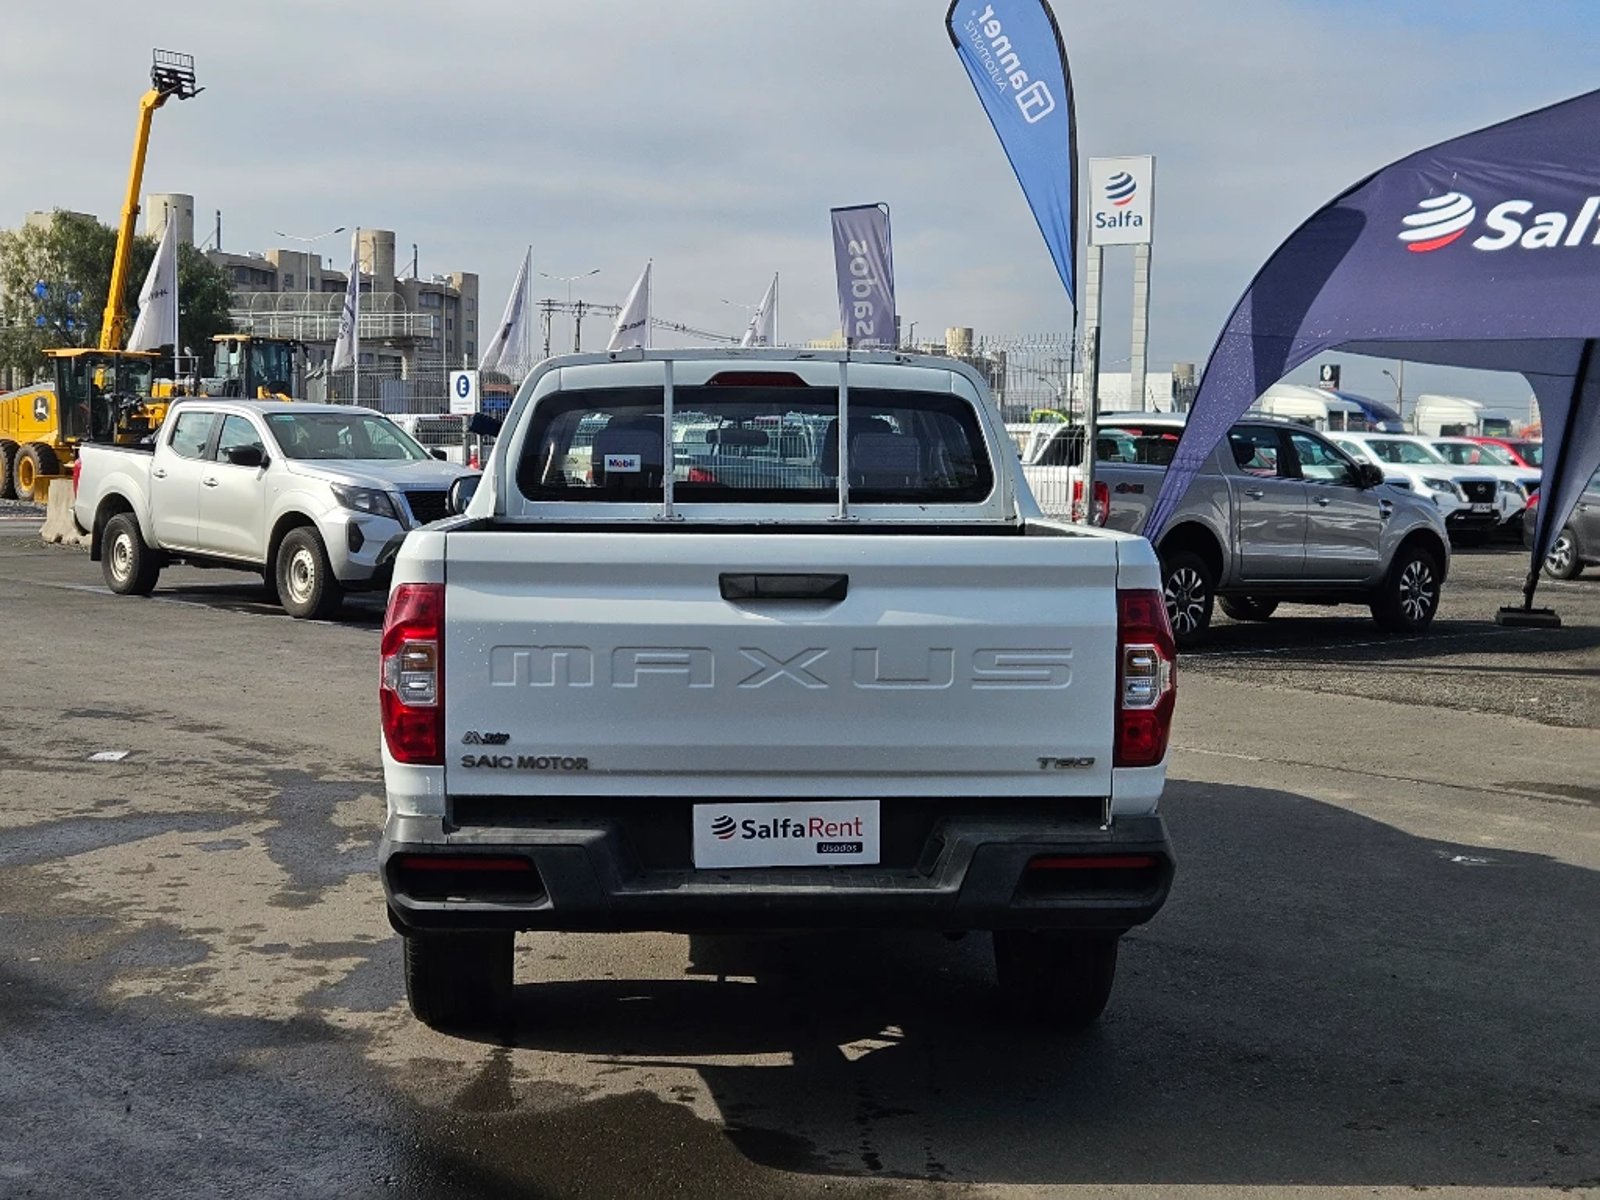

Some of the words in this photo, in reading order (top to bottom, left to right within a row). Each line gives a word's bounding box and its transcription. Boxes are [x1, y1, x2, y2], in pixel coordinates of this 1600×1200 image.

[1095, 211, 1143, 229] Salfa
[1472, 195, 1600, 251] Sal
[608, 458, 636, 468] Mobil
[489, 644, 1074, 690] MAXUS
[461, 754, 513, 769] SAIC
[516, 755, 589, 771] MOTOR
[741, 816, 864, 840] SalfaRent
[821, 843, 859, 853] Usados
